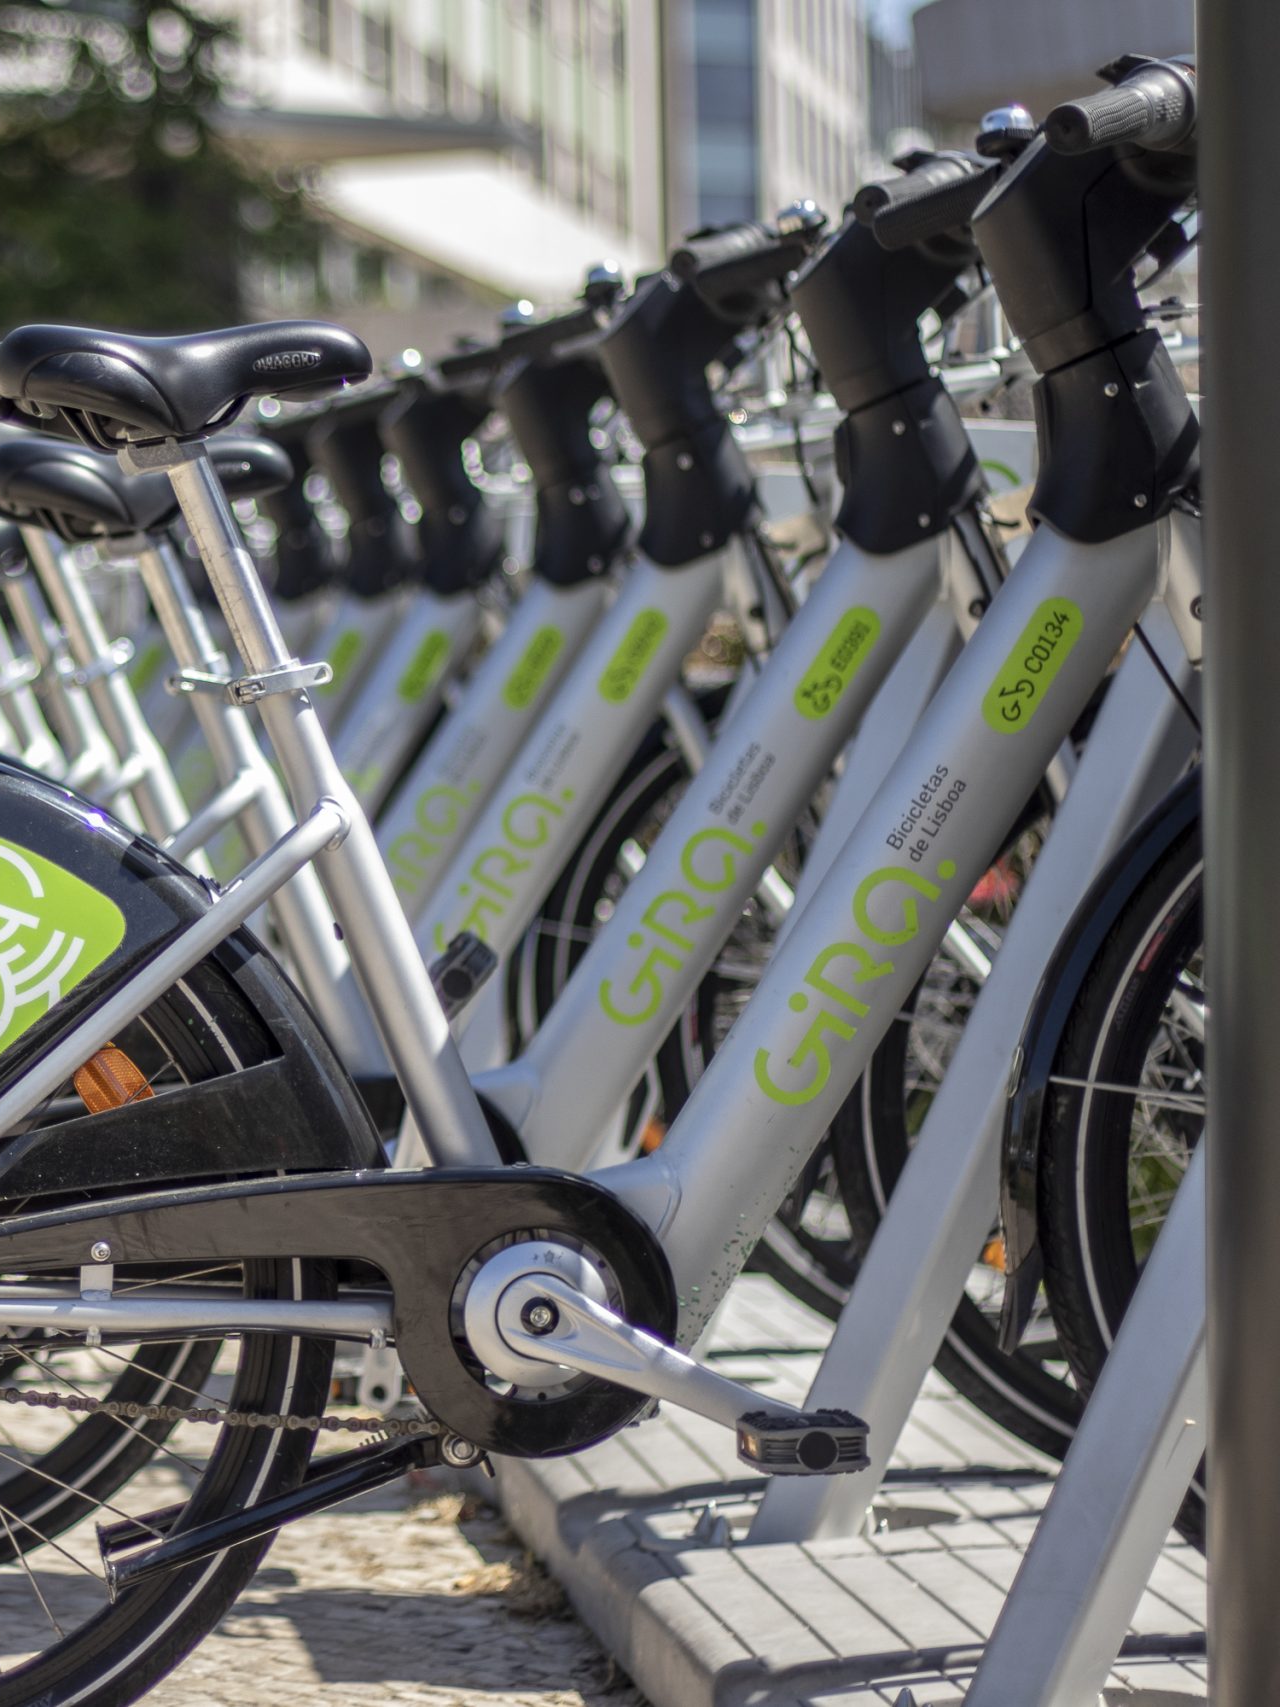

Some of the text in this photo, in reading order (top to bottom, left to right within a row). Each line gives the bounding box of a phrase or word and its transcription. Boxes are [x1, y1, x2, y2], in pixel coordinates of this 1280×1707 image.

[1024, 611, 1070, 674] C0134
[886, 764, 949, 851] Bicicletas
[909, 779, 967, 863] de Lisboa
